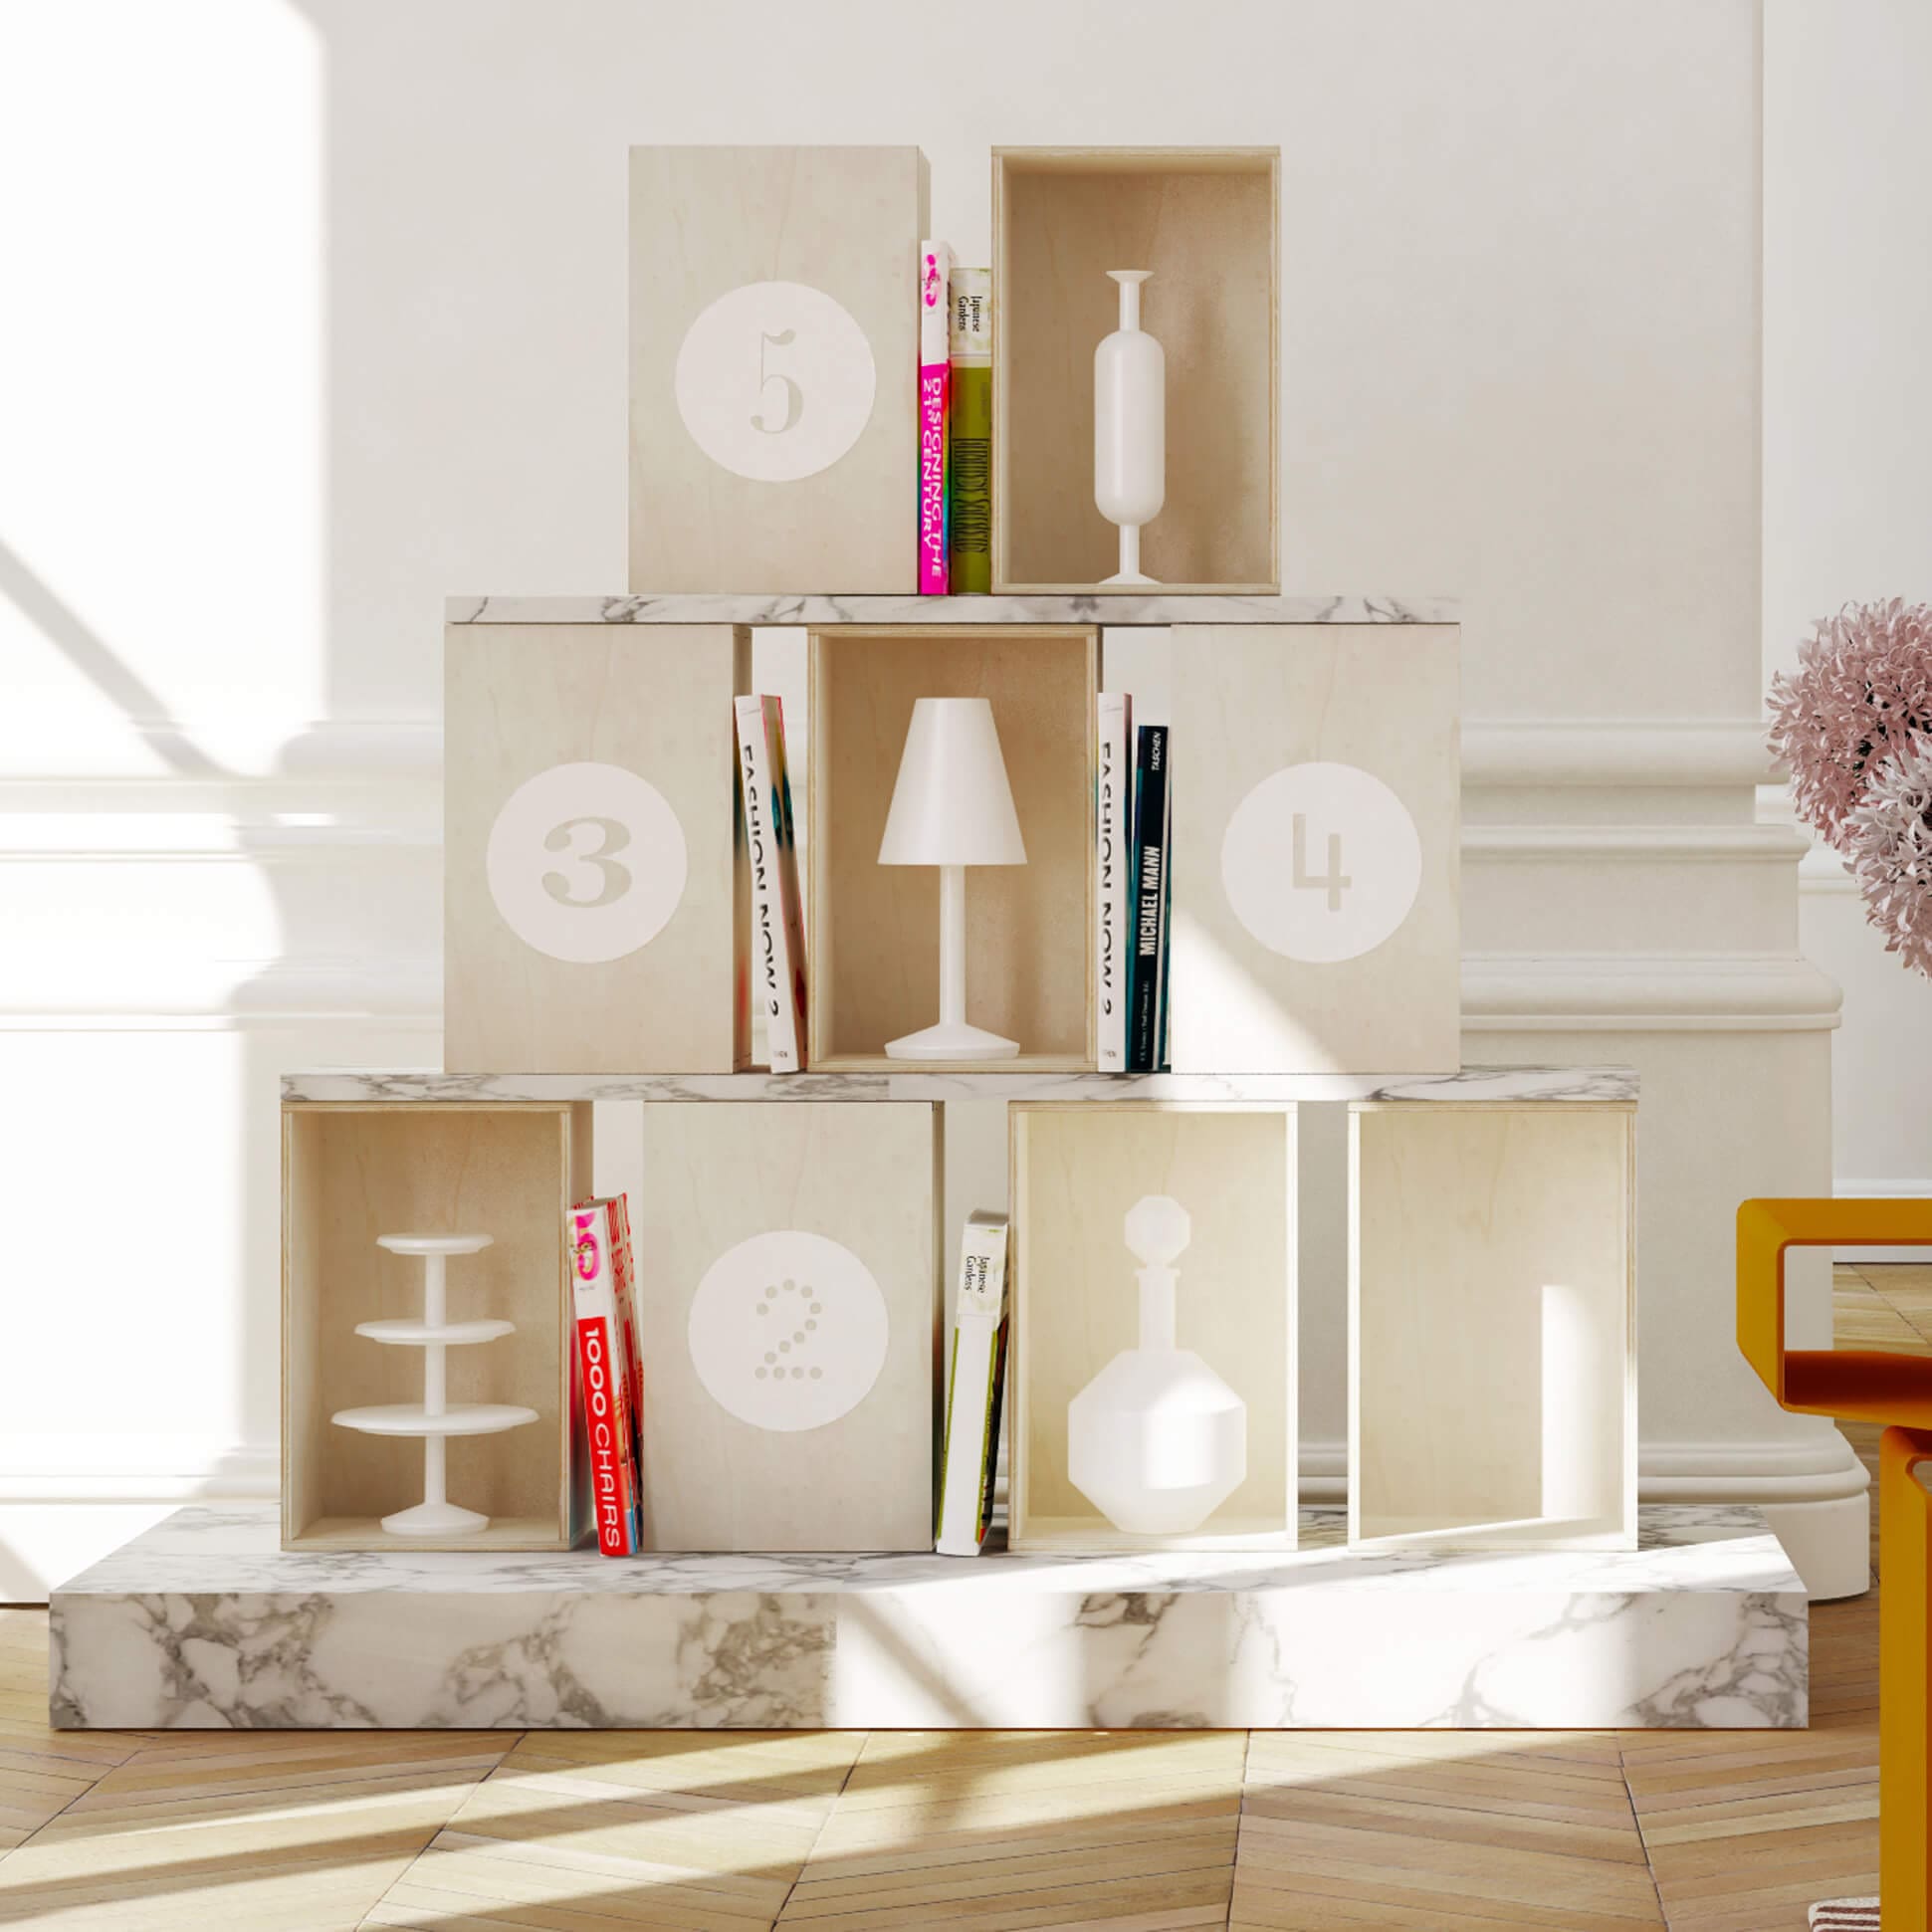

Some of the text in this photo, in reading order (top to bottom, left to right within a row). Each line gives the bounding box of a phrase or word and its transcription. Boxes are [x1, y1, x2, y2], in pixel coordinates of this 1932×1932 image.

[958, 296, 969, 331] Gardens
[969, 296, 983, 332] Japanese
[750, 327, 804, 434] 5
[922, 430, 934, 548] CENTURY
[931, 377, 943, 576] DESIGNING THE
[1151, 732, 1163, 772] TASCHEN
[541, 816, 633, 909] 3
[1139, 845, 1162, 957] MICHAEL MANN
[1293, 813, 1352, 911] 4
[754, 1279, 822, 1380] 2
[584, 1327, 621, 1548] 1000 CHAIRS
